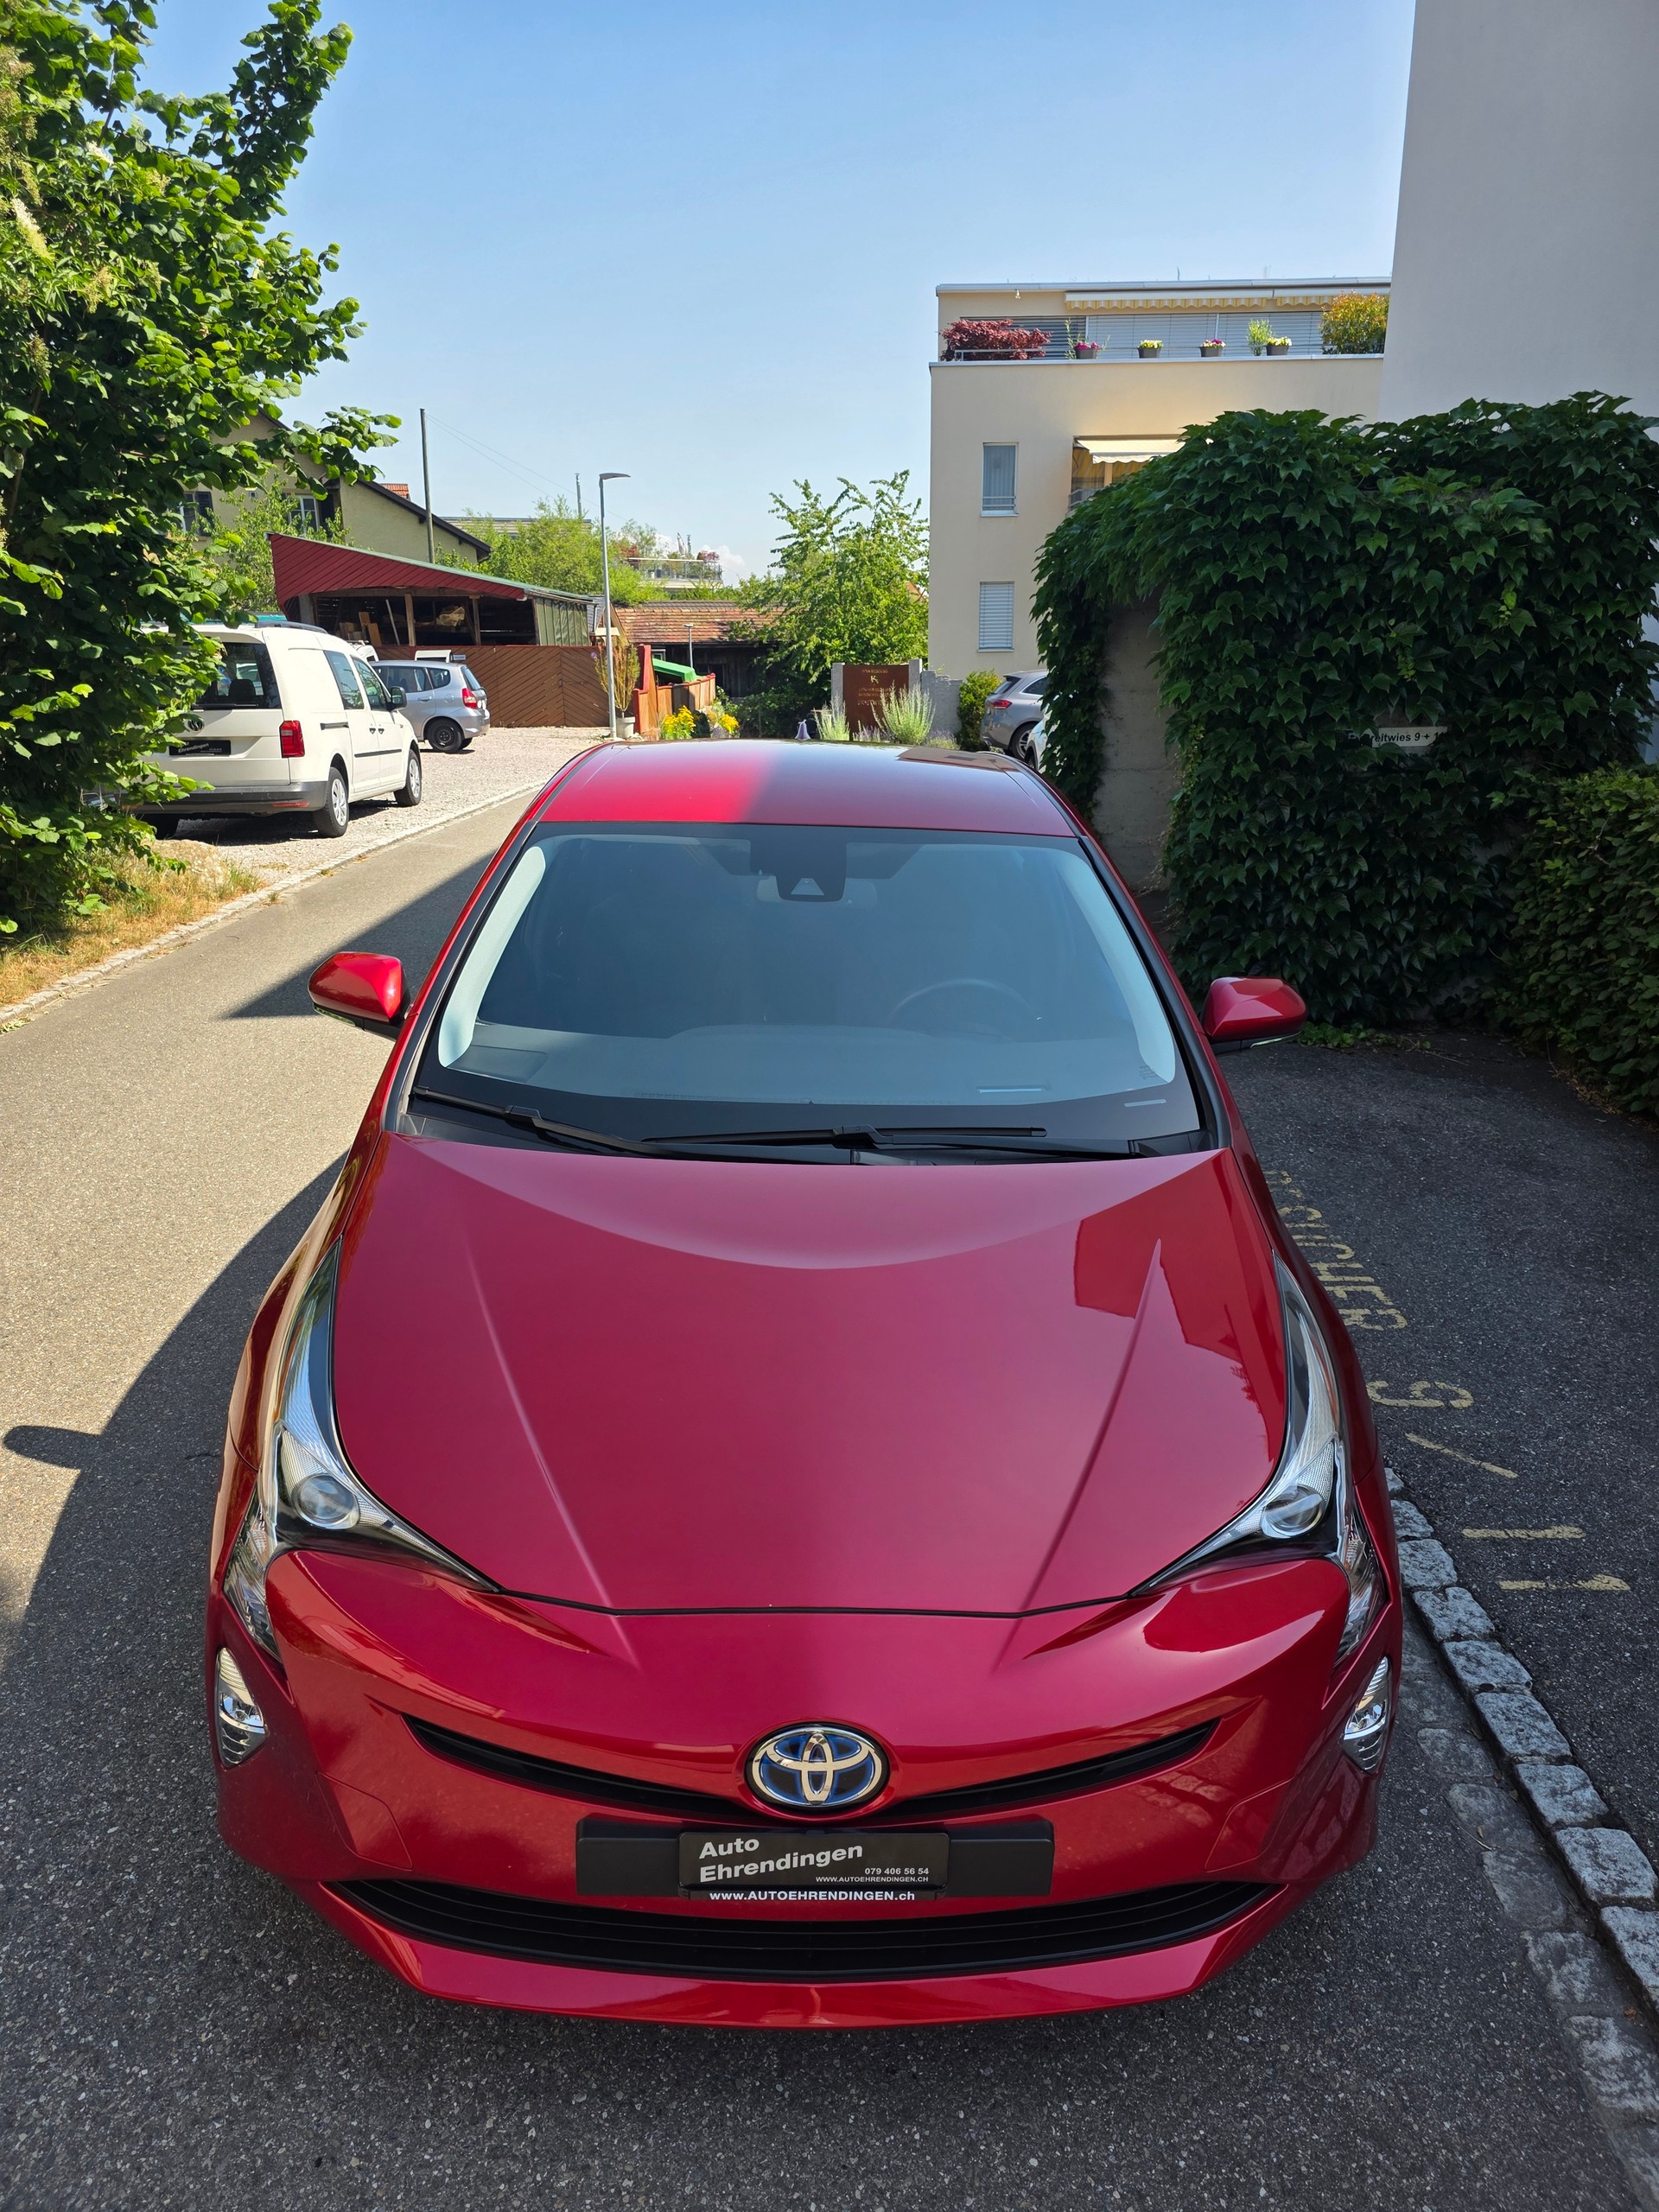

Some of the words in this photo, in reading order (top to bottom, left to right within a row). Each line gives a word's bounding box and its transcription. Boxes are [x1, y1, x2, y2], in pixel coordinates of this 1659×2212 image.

[1370, 733, 1412, 743] reitwies
[1414, 733, 1421, 741] 9
[699, 1838, 760, 1859] Auto
[700, 1845, 863, 1883] Ehrendingen
[709, 1891, 915, 1901] www.AUTOEHRENDINGEN.ch
